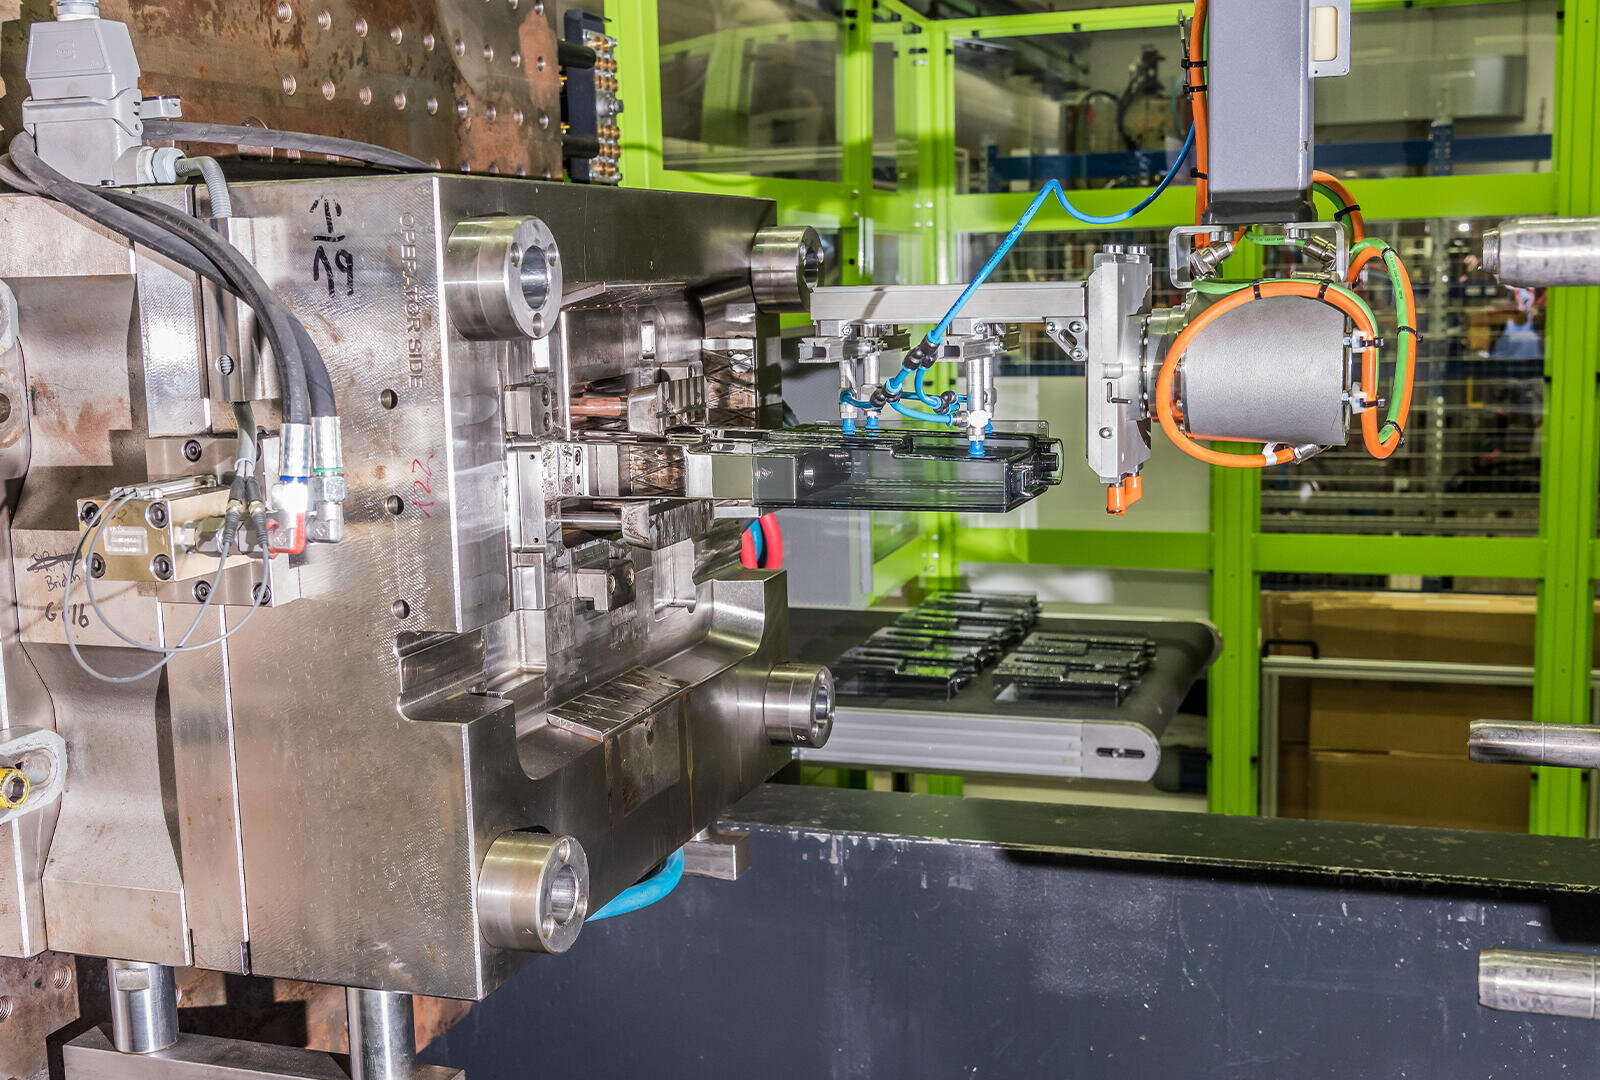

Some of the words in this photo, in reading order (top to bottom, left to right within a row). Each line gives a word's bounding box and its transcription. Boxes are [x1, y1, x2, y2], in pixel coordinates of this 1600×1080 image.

[313, 245, 354, 297] 19
[400, 211, 421, 333] OPERATOR
[408, 338, 424, 388] SIDE
